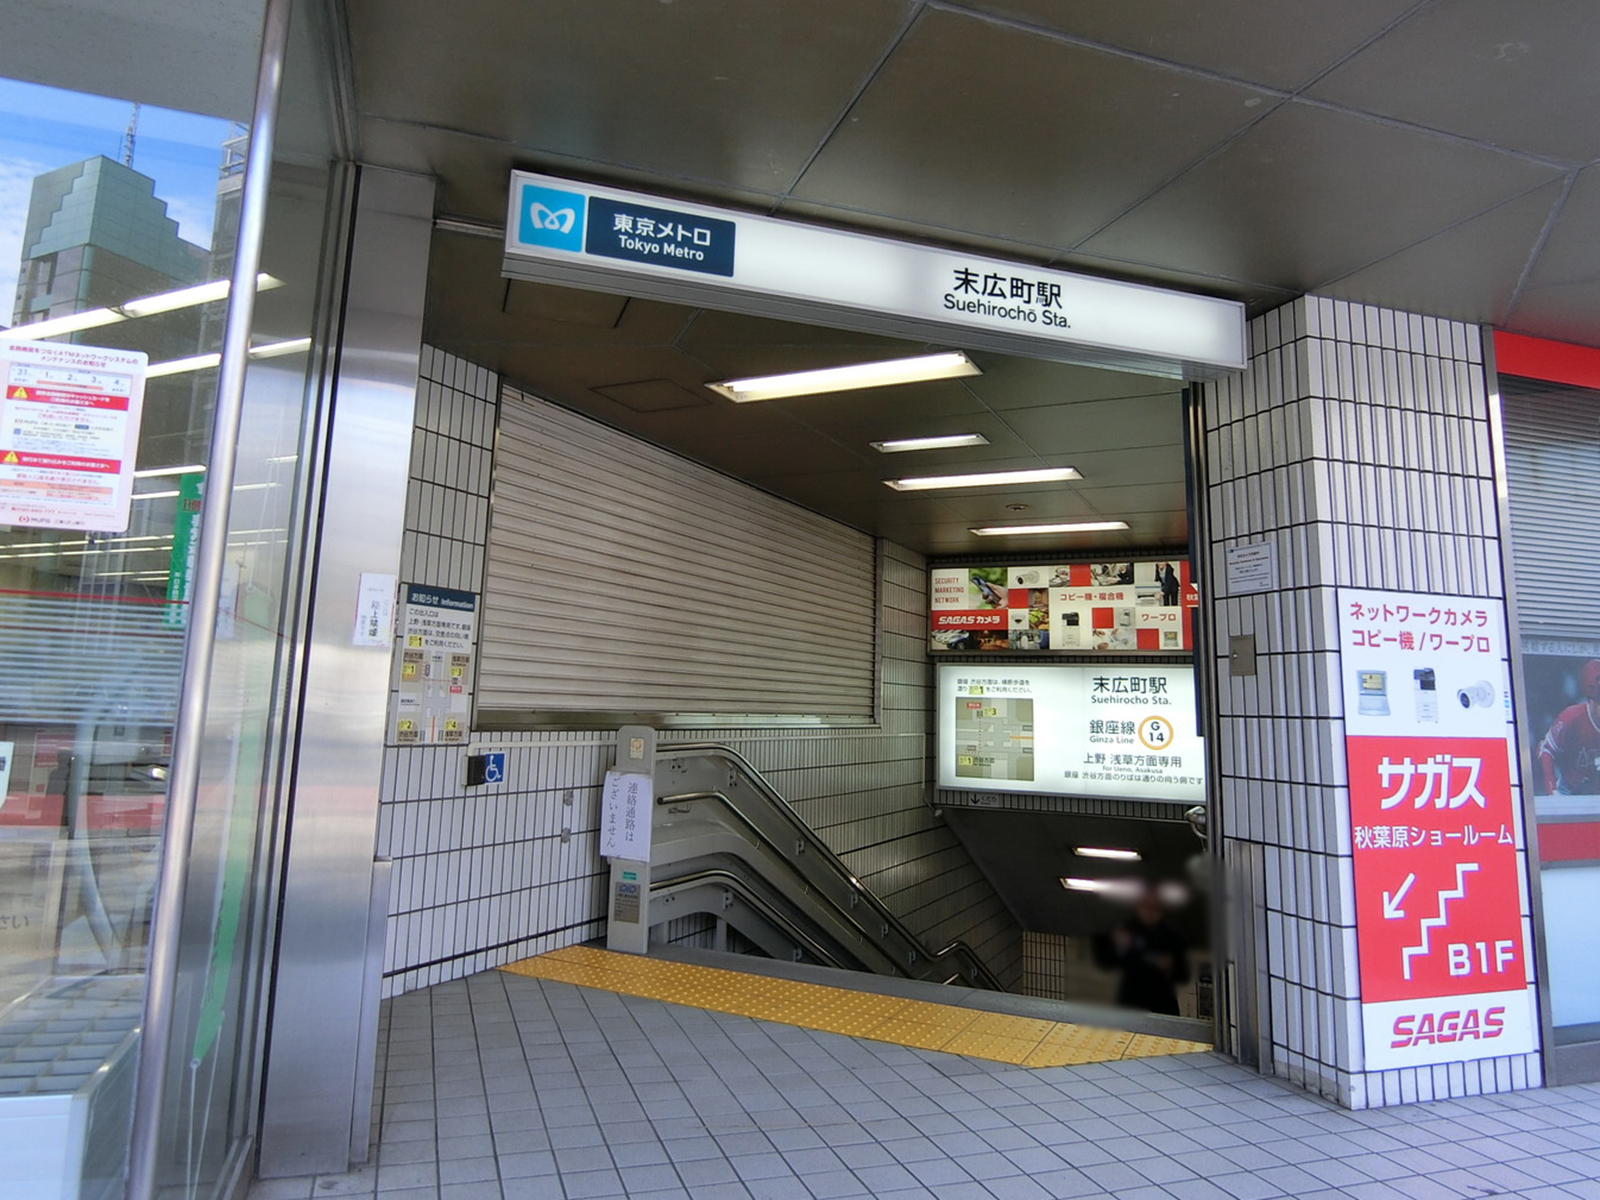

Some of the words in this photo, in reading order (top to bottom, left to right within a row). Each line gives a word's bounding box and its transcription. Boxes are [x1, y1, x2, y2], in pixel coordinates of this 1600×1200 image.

[613, 213, 711, 246] 東京メトロ
[618, 234, 660, 255] Tokyo
[663, 242, 704, 261] Metro
[953, 267, 1063, 309] 末広町駅
[1041, 309, 1071, 329] Sta.
[934, 577, 959, 585] SECURITY
[411, 592, 440, 605] お知らせ
[440, 598, 474, 609] Information
[938, 615, 976, 625] SAGAS
[976, 615, 1001, 624] カメラ
[1141, 613, 1177, 622] ワープロ
[1350, 601, 1488, 628] ネットワークカメラ
[1092, 676, 1167, 694] 末広町駅
[1151, 695, 1172, 705] Sta.
[1089, 719, 1135, 735] 銀座線
[1150, 721, 1161, 731] G
[1089, 735, 1114, 744] Ginza
[1116, 736, 1135, 744] Line
[1149, 732, 1164, 742] 14
[1083, 752, 1106, 765] 上野
[1110, 753, 1182, 768] 浅草方面専用
[1064, 770, 1079, 779] 銀座
[1377, 754, 1486, 810] サガス
[606, 777, 621, 848] ございません
[625, 782, 638, 842] 連絡通路は
[1354, 824, 1513, 849] 秋葉原ショールーム
[1448, 940, 1514, 977] B1F
[1390, 1007, 1505, 1049] SAGAS
